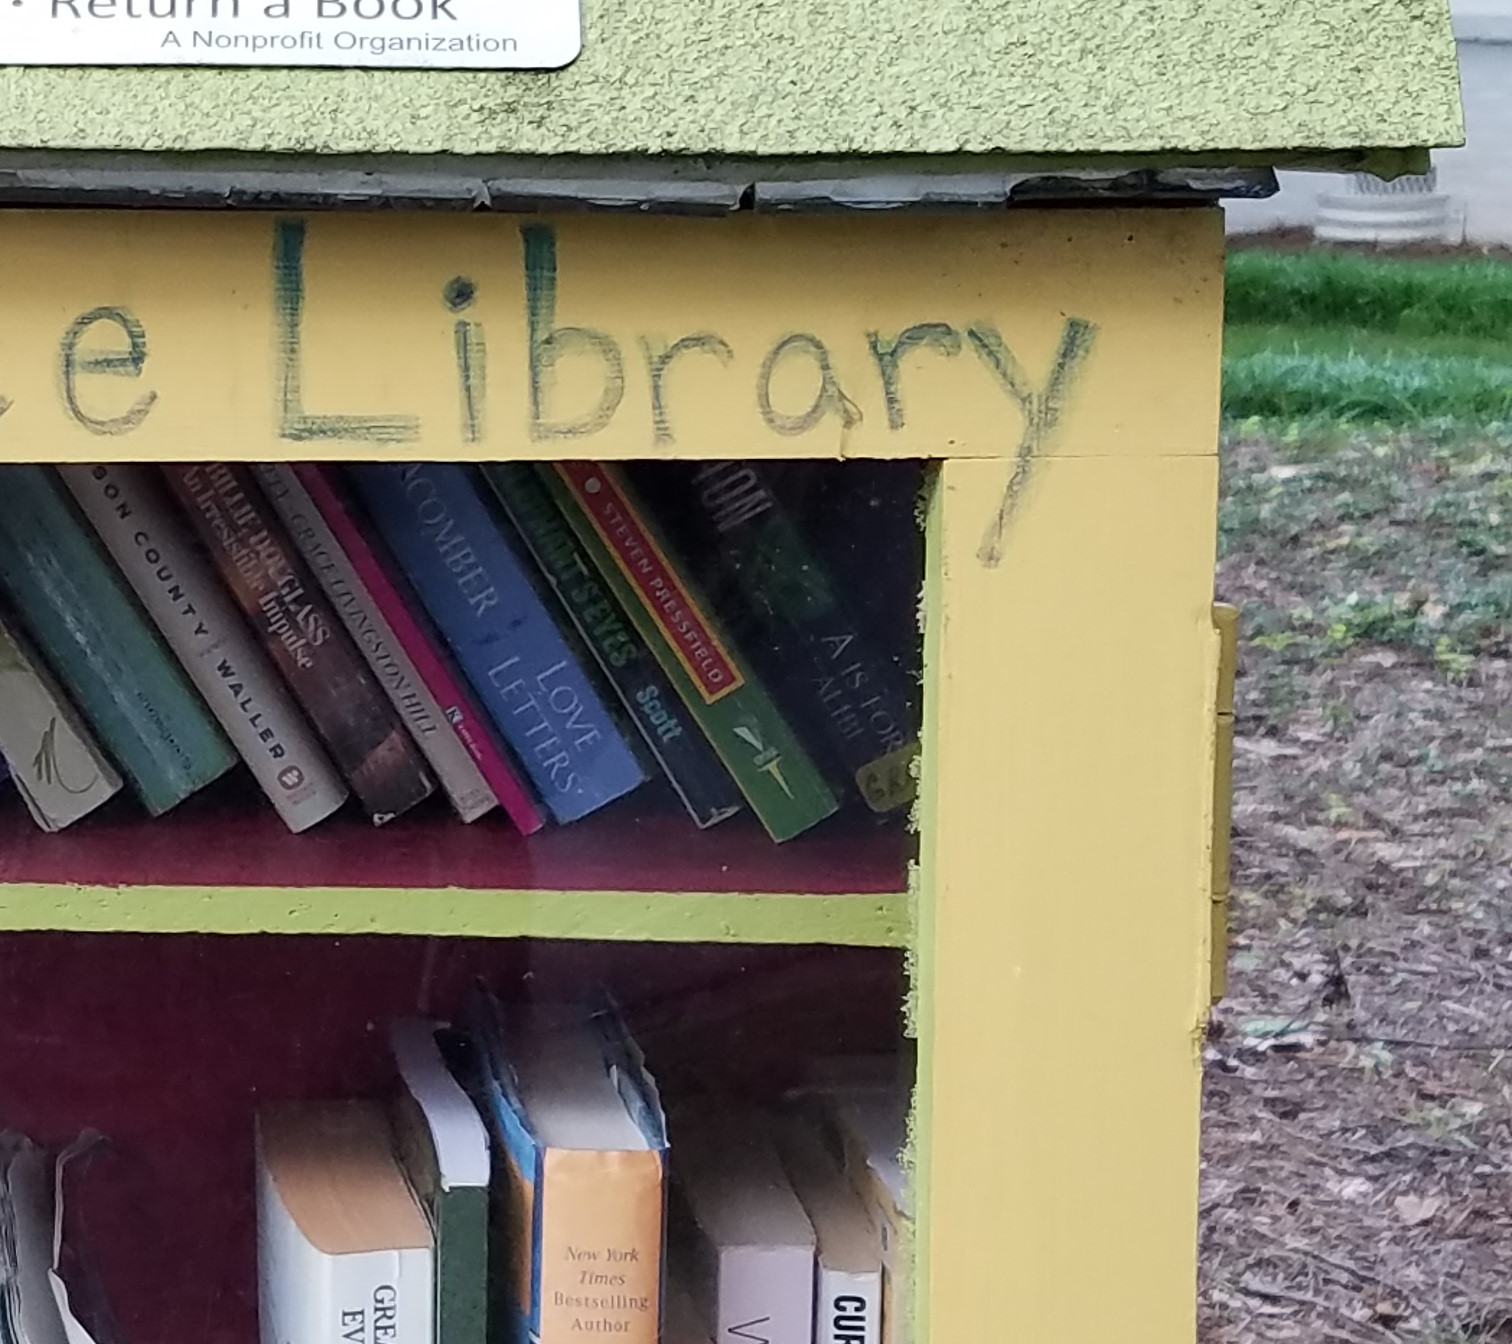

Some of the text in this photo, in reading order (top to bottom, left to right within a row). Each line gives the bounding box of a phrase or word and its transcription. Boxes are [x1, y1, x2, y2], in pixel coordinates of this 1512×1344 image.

[160, 30, 518, 53] A Nonprofit Organization
[270, 219, 1100, 567] Library
[259, 590, 314, 669] Impulse
[290, 513, 438, 737] GRACE LIVINGSTON HILL
[601, 501, 725, 686] STEVEN PRESSFIELD
[134, 530, 209, 639] COUNTY
[216, 657, 286, 761] WALLER
[488, 655, 585, 795] LETTERS
[535, 659, 602, 752] LOVE
[636, 684, 684, 745] Scott
[565, 1245, 640, 1263] New York
[578, 1269, 626, 1287] Times
[554, 1290, 649, 1311] Bestselling
[571, 1317, 631, 1333] Author
